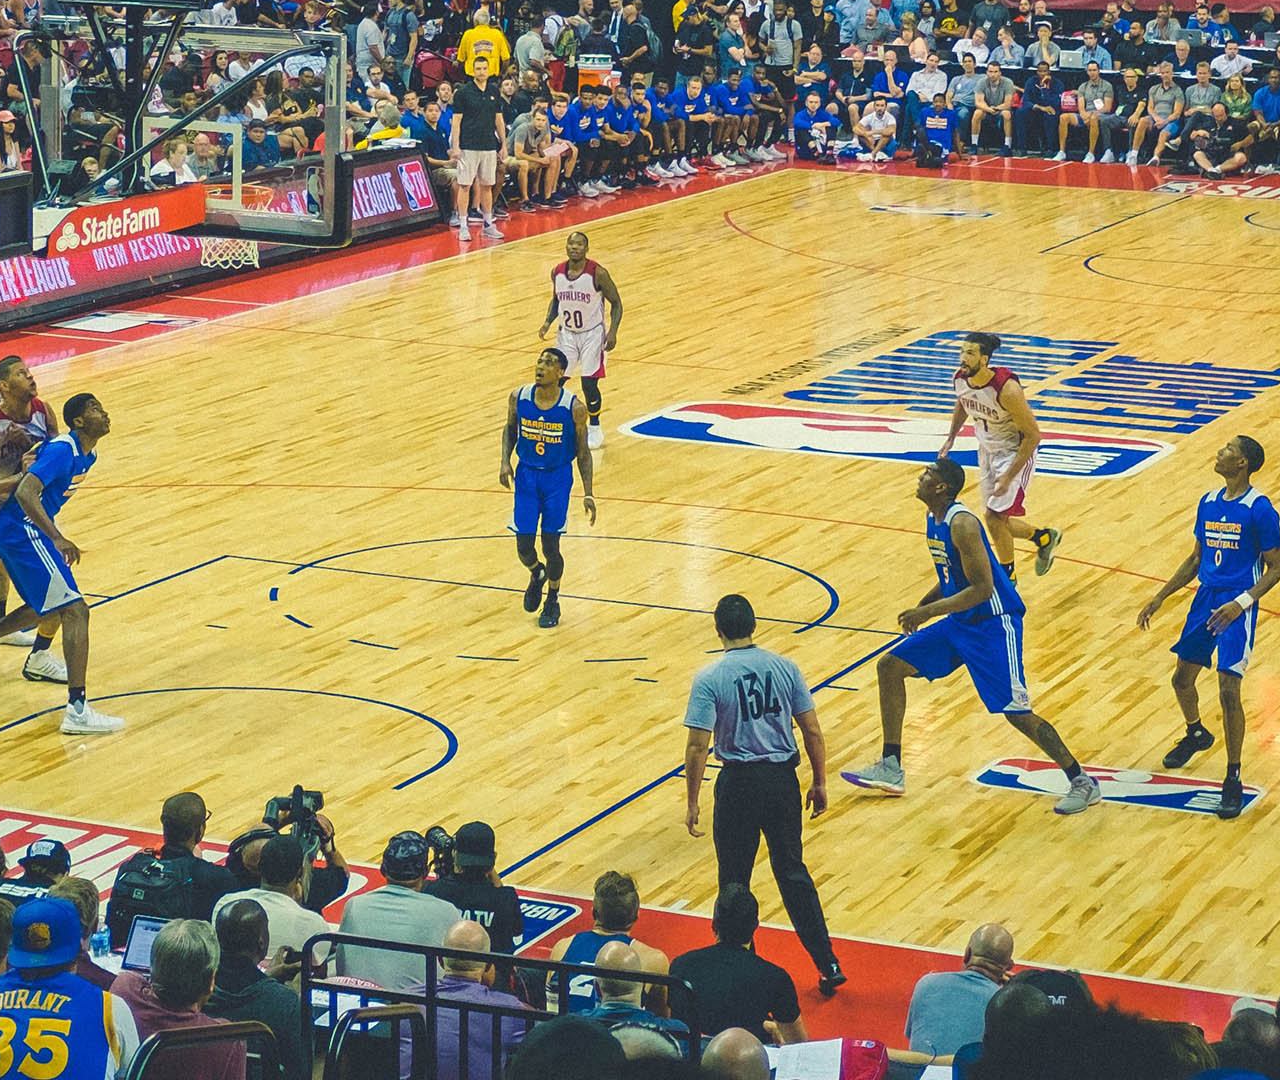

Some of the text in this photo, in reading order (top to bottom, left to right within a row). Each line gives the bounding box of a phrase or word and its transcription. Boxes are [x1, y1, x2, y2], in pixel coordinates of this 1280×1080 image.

[357, 172, 402, 217] LEAGUE
[410, 171, 428, 199] TV
[92, 242, 129, 271] MGM
[129, 233, 191, 263] RESORTS
[19, 256, 77, 296] LEAGUE
[563, 310, 583, 328] 20
[535, 442, 545, 455] 6
[1214, 549, 1222, 566] 0
[733, 670, 782, 722] 134
